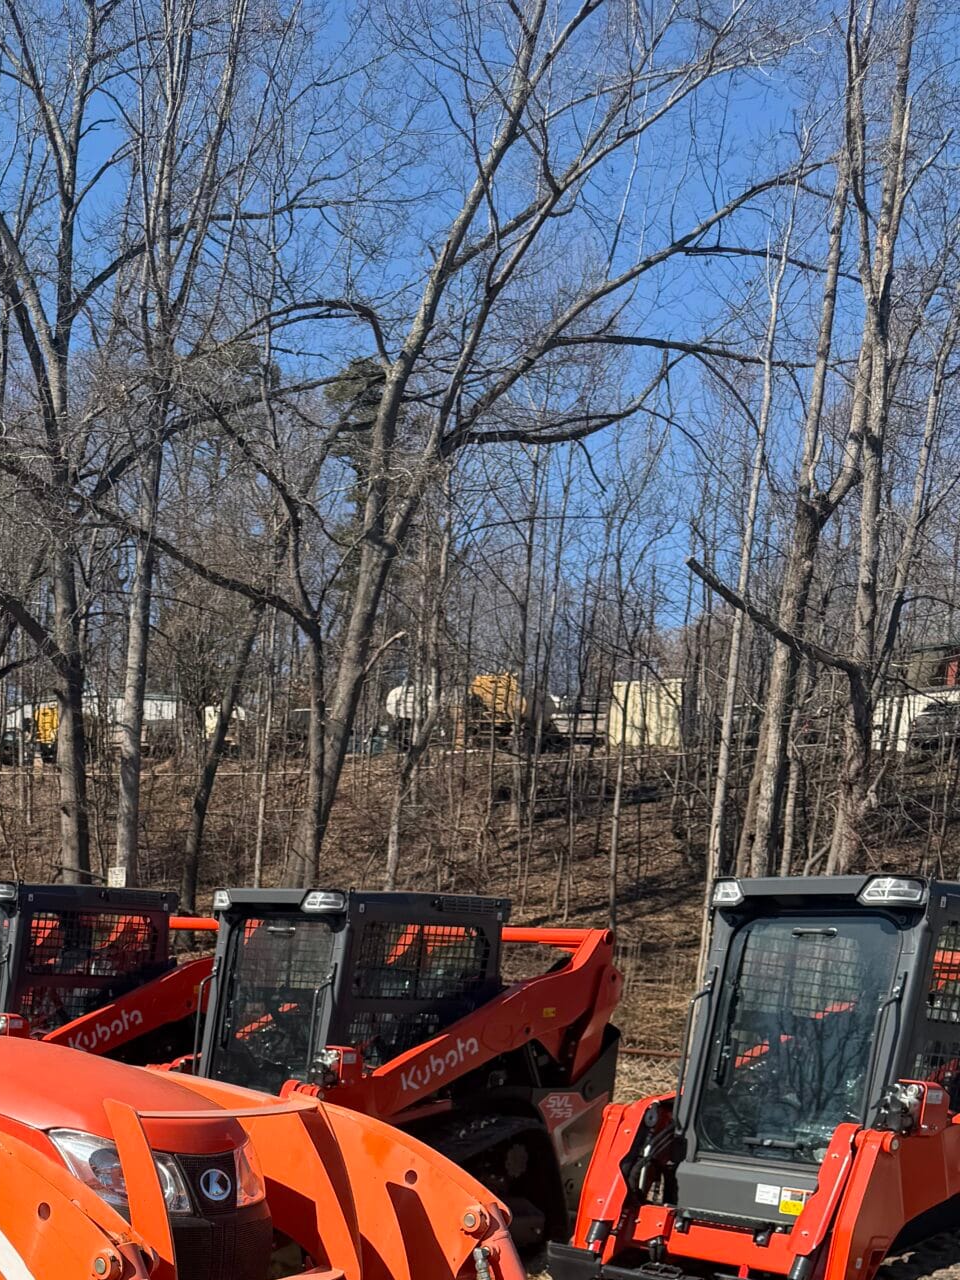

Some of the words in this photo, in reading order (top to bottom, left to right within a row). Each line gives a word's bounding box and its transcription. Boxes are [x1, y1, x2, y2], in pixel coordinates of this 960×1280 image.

[68, 1009, 144, 1052] Kubota
[401, 1037, 480, 1091] Kubota
[546, 1095, 574, 1108] SVL
